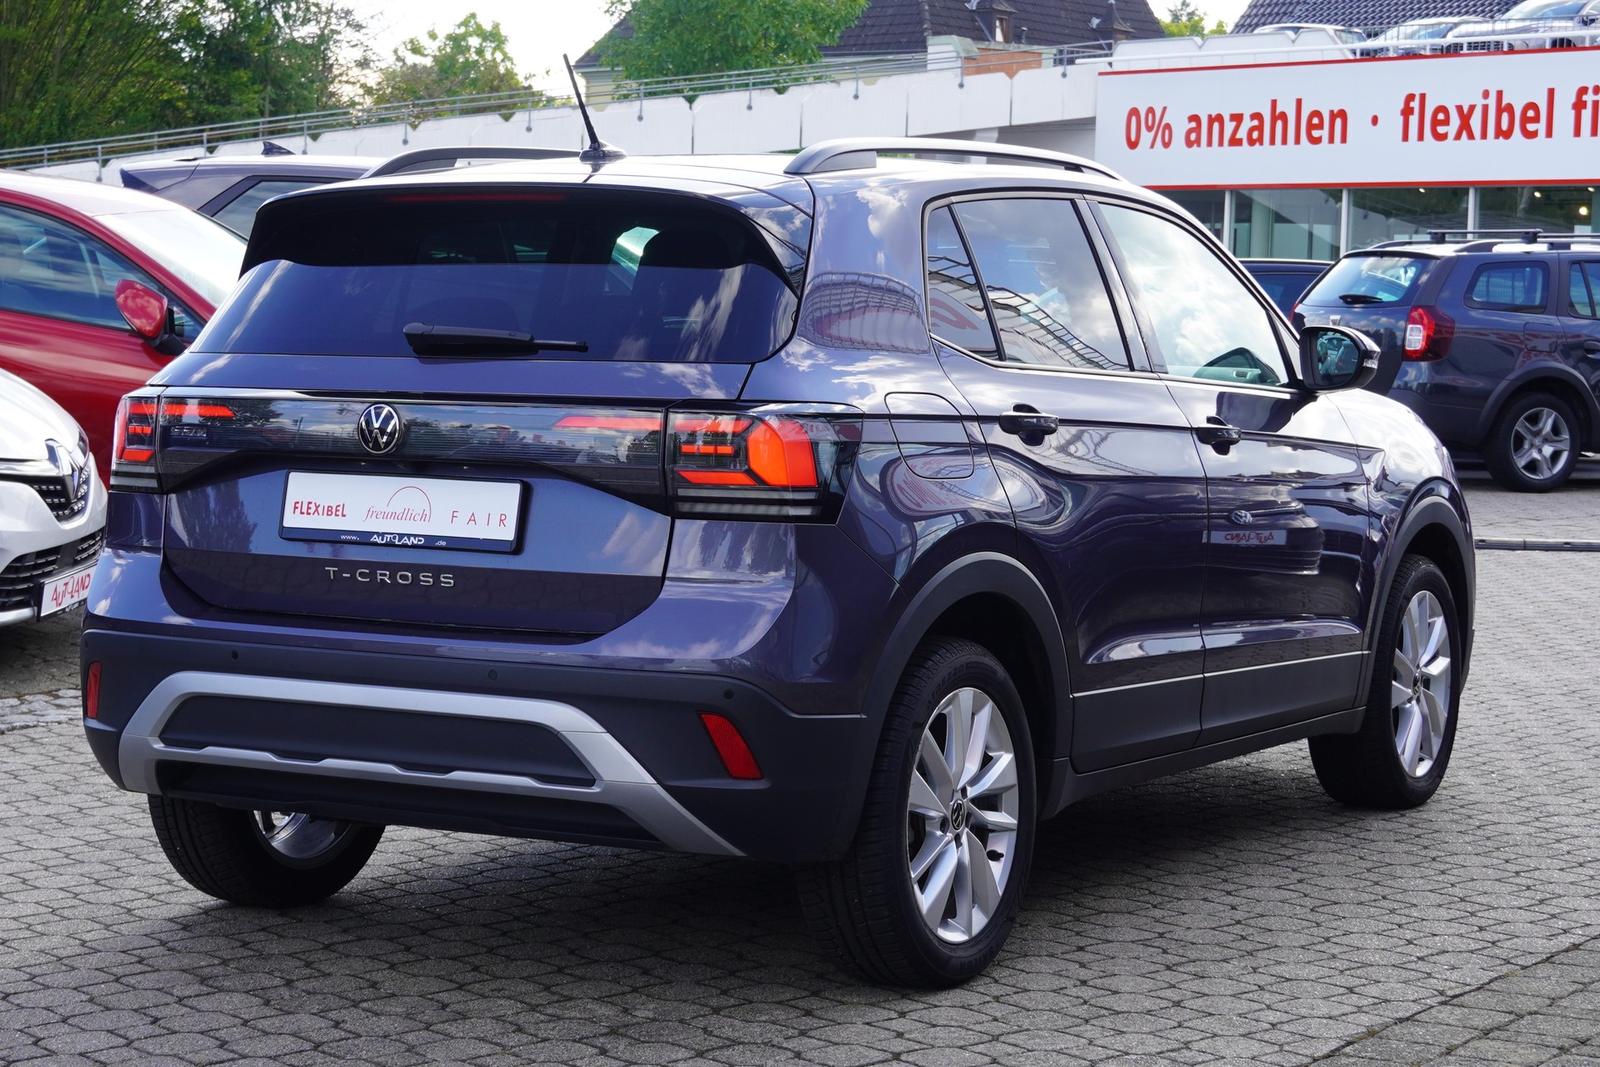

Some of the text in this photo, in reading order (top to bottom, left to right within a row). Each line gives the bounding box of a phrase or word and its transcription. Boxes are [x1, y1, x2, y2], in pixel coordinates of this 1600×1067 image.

[1124, 106, 1173, 151] 0%
[1184, 98, 1349, 149] anzahlen
[1400, 87, 1556, 143] flexibel
[292, 493, 509, 528] FLEXIBEL freundlich FAIR
[370, 533, 425, 546] AUTOLAND
[324, 566, 456, 588] T-CROSS
